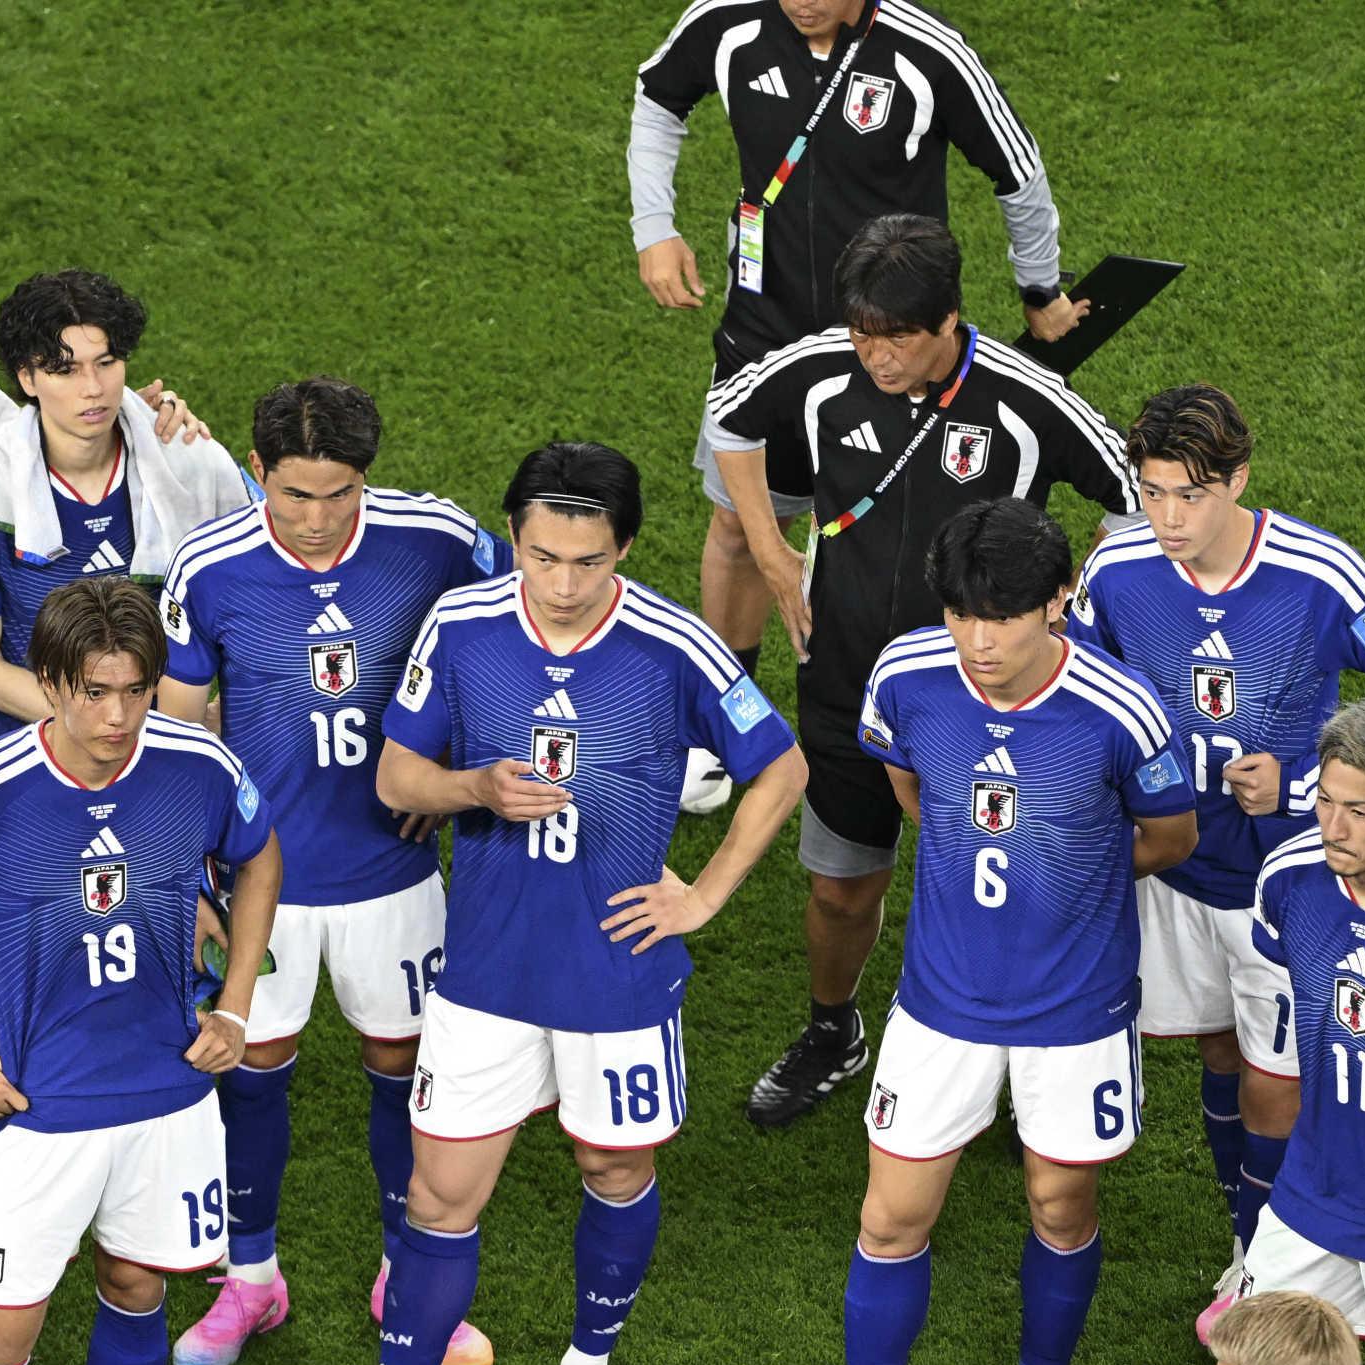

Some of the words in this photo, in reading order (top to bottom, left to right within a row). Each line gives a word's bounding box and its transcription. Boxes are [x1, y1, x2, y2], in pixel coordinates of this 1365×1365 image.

[814, 87, 837, 116] WORLD
[904, 429, 928, 457] WORLD
[956, 425, 981, 435] JAPAN
[321, 643, 345, 652] JAPAN
[1203, 667, 1226, 676] JAPAN
[310, 707, 367, 768] 16
[543, 728, 568, 738] JAPAN
[543, 765, 564, 777] JFA
[1191, 732, 1243, 796] 17
[984, 783, 1008, 792] JAPAN
[527, 800, 579, 864] 18
[92, 865, 116, 874] JAPAN
[974, 847, 1010, 909] 6
[82, 922, 137, 988] 19
[602, 1063, 661, 1127] 18
[1092, 1079, 1125, 1141] 6
[181, 1177, 225, 1249] 19
